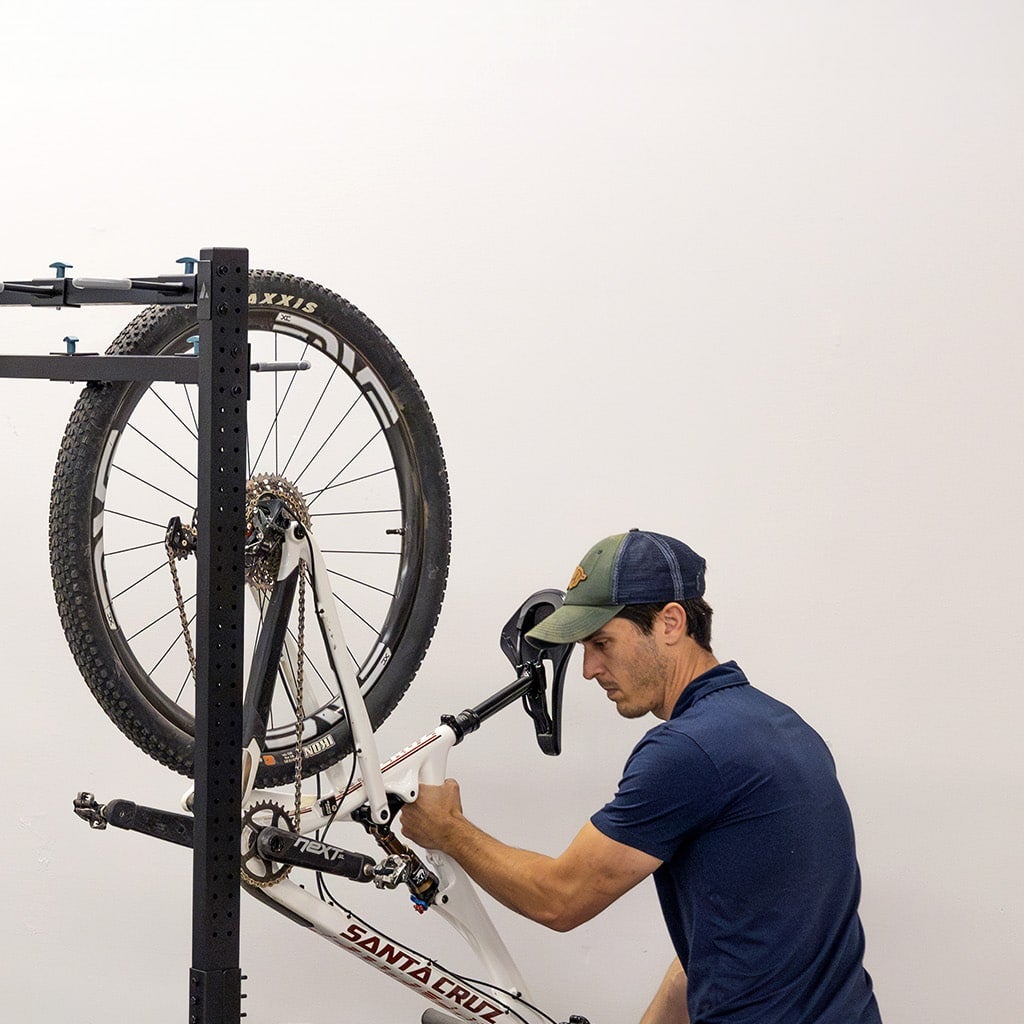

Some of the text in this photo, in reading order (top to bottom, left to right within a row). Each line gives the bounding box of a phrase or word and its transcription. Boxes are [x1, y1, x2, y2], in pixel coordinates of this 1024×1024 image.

[248, 292, 318, 314] AXXIS
[303, 733, 335, 758] IKON
[339, 923, 504, 1024] SANTA CRUZ
